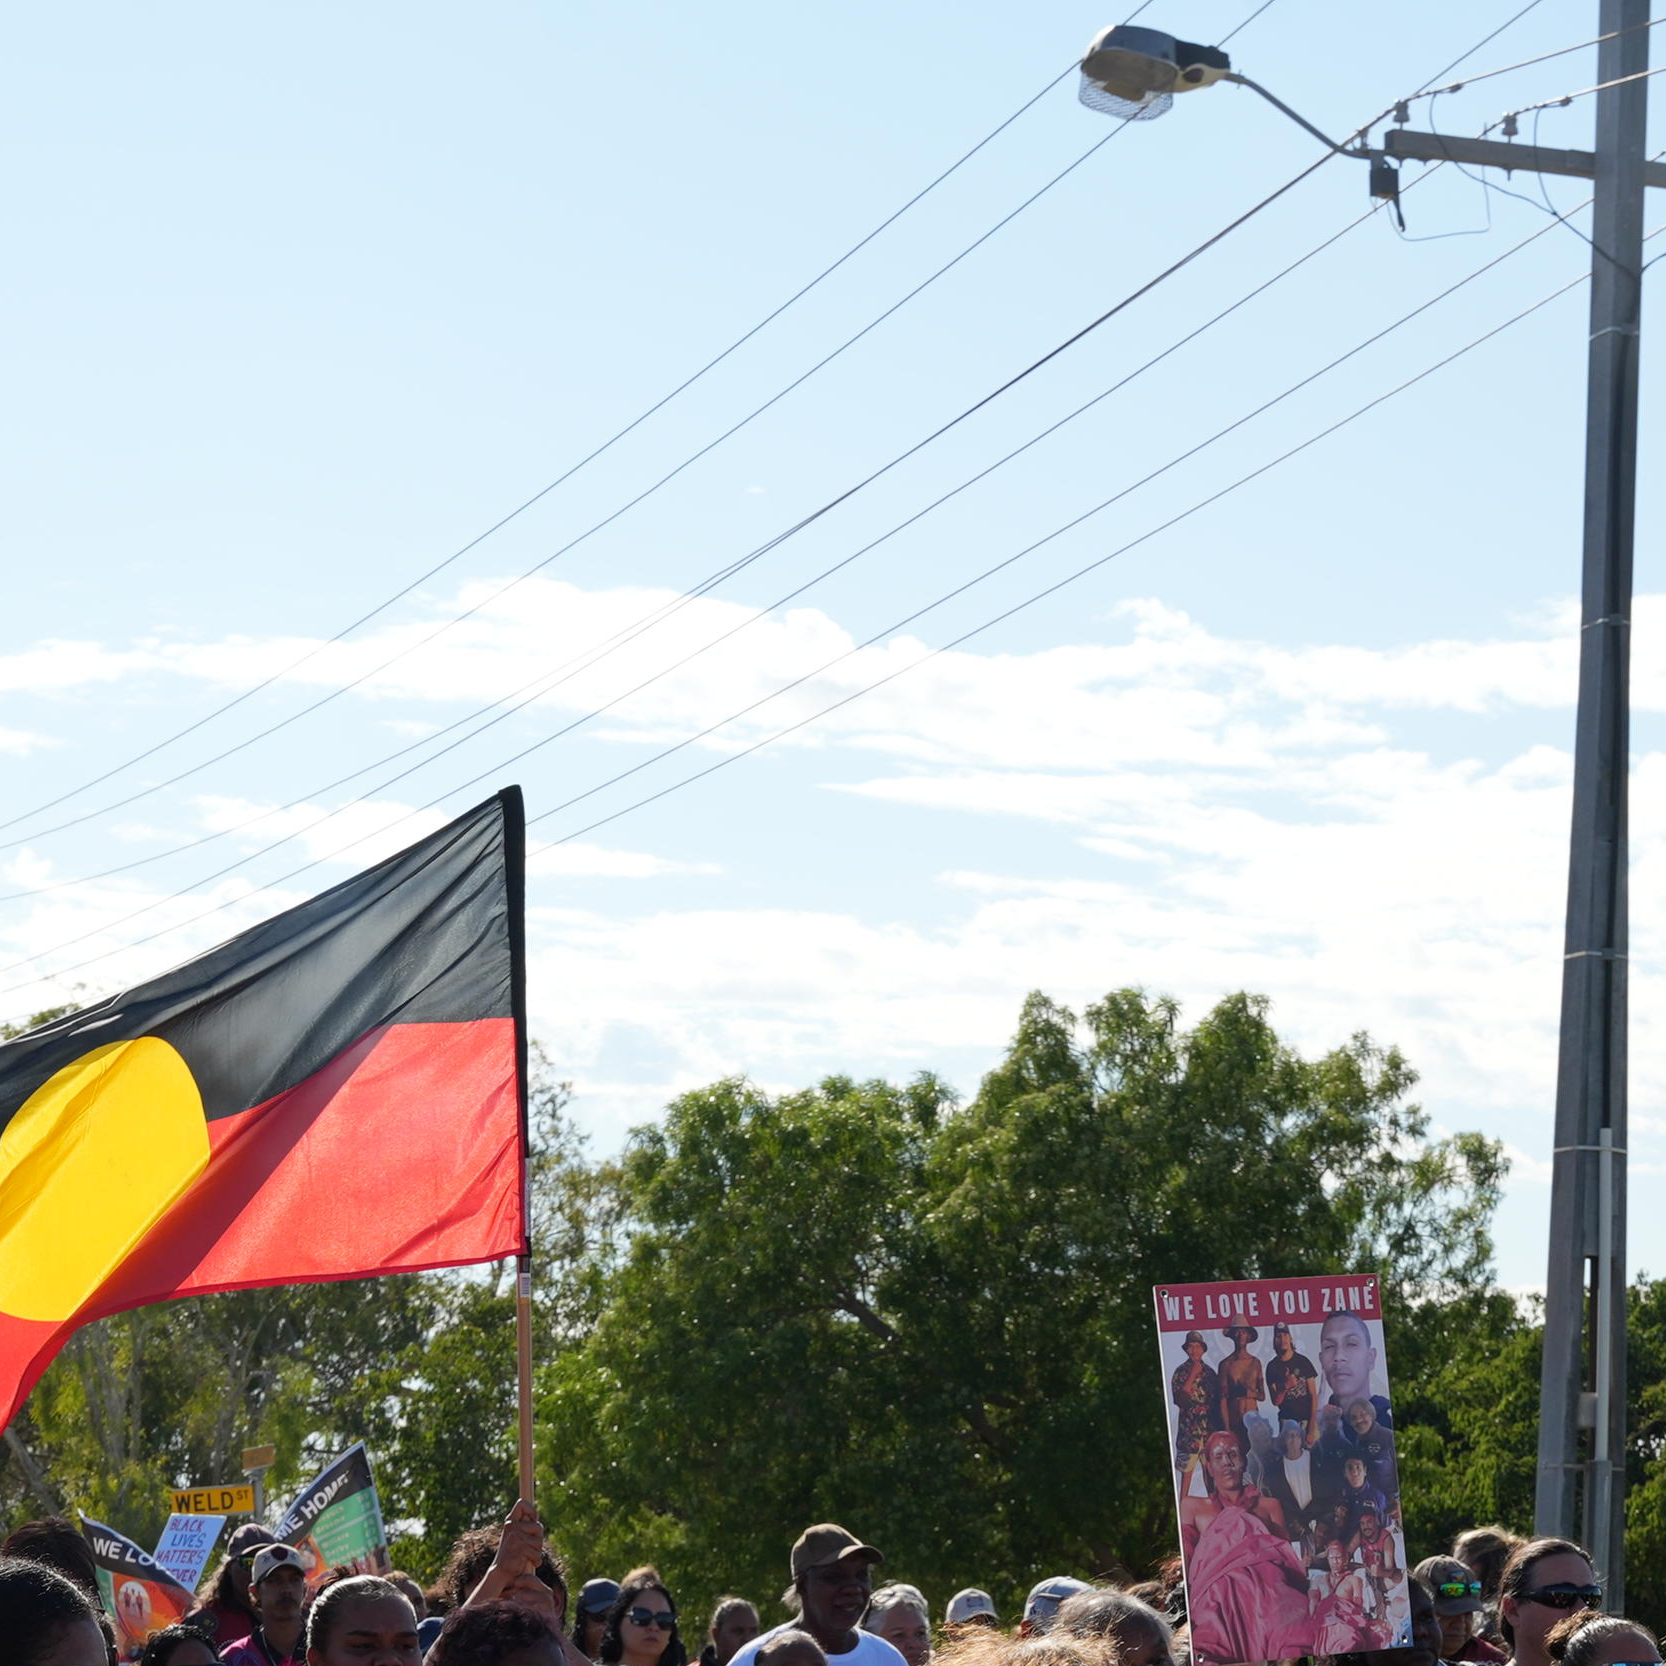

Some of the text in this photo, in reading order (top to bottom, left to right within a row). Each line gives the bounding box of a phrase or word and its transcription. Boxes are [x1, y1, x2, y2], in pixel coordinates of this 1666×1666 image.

[1163, 1286, 1374, 1321] WE LOVE YOU ZANE
[175, 1489, 250, 1513] WELD ST
[170, 1519, 205, 1532] BLACK
[93, 1536, 122, 1557] WE
[171, 1532, 206, 1547] LIVES
